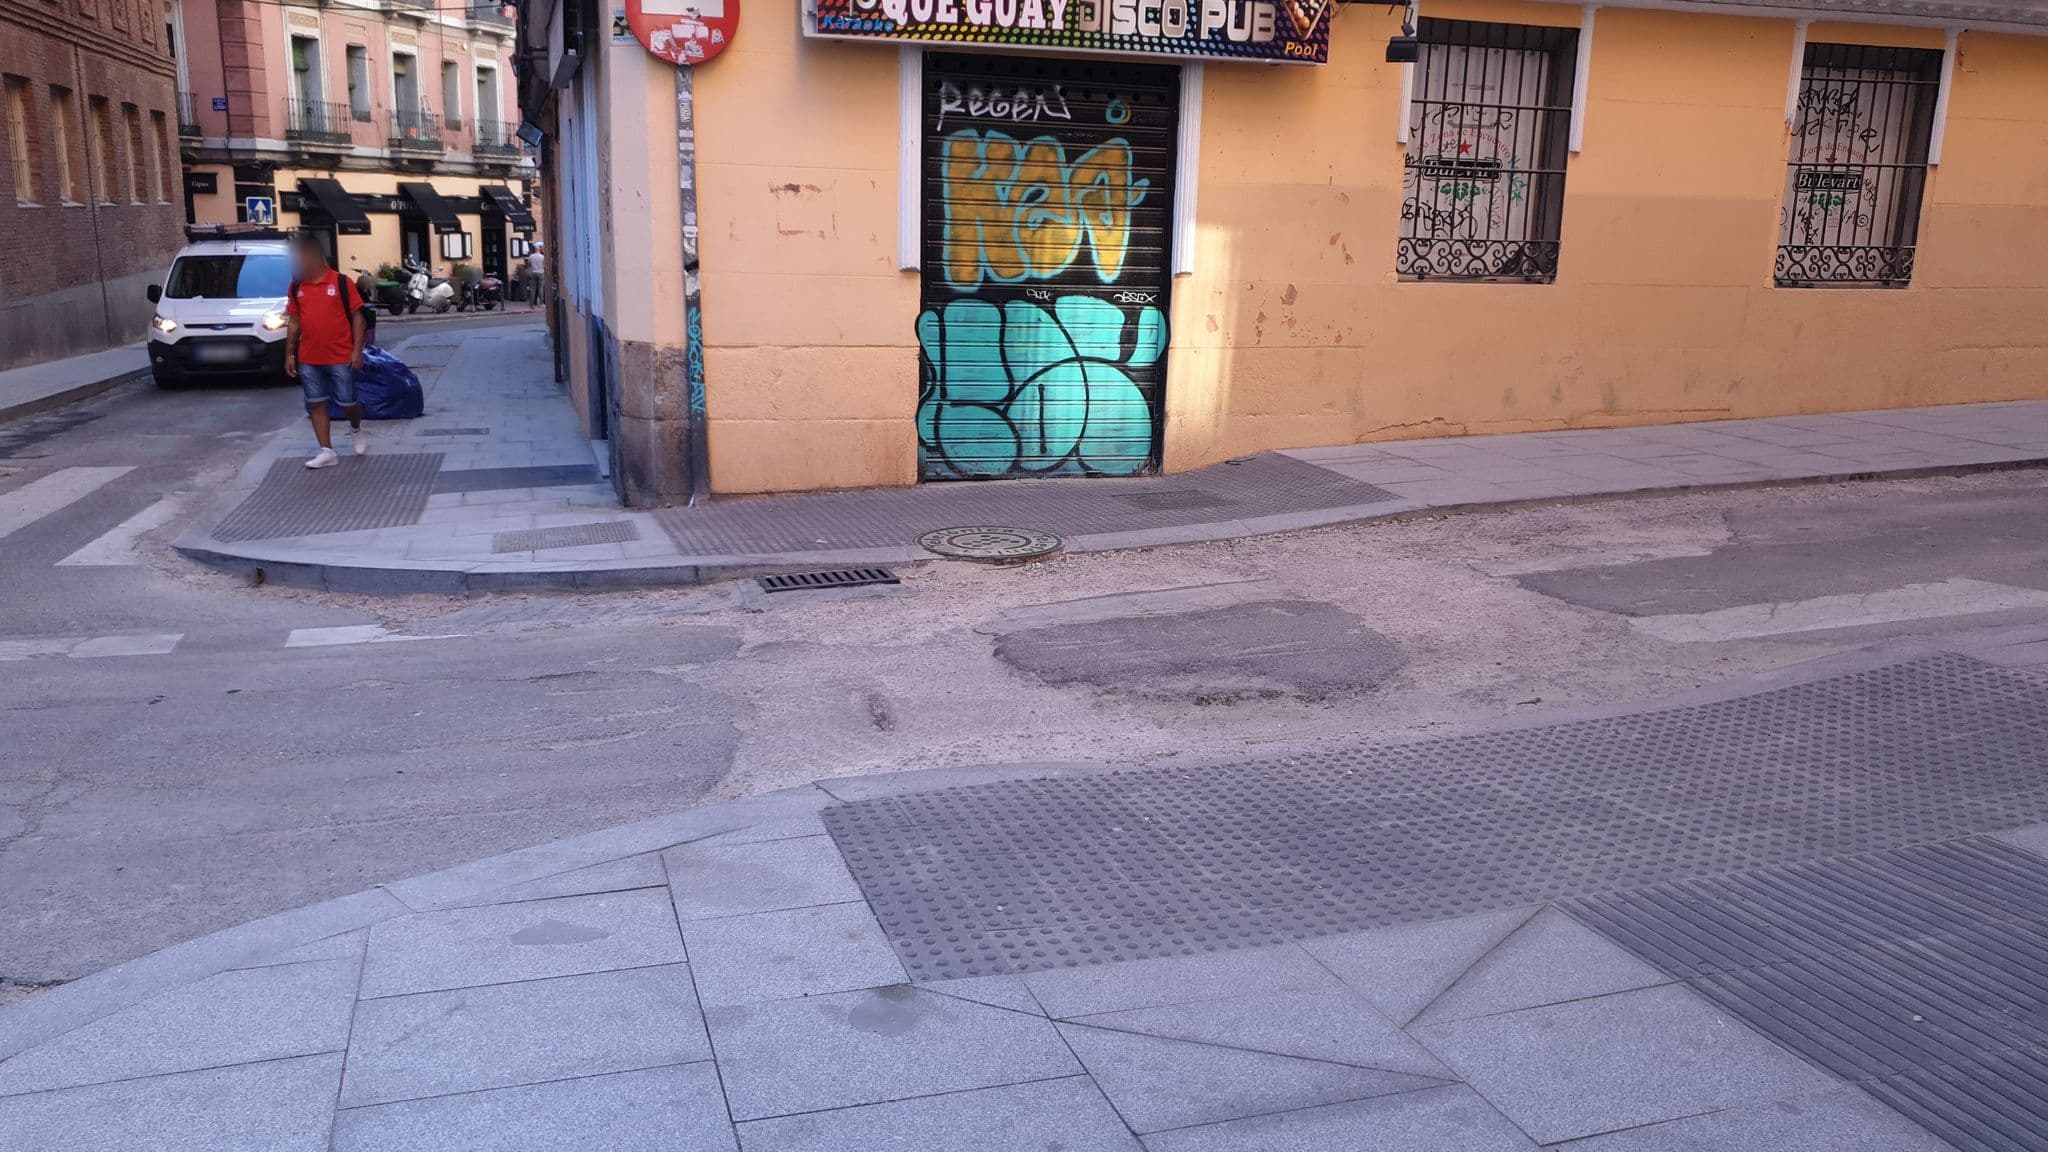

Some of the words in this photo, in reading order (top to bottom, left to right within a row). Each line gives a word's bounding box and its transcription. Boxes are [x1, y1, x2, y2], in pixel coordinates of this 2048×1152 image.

[823, 14, 895, 32] Karaoke
[882, 0, 958, 25] QUE
[966, 0, 1067, 30] GUAY
[1079, 0, 1188, 38] DISCO
[1201, 0, 1276, 42] PUB
[1284, 41, 1319, 57] Pool
[1470, 129, 1511, 158] Ecuentro
